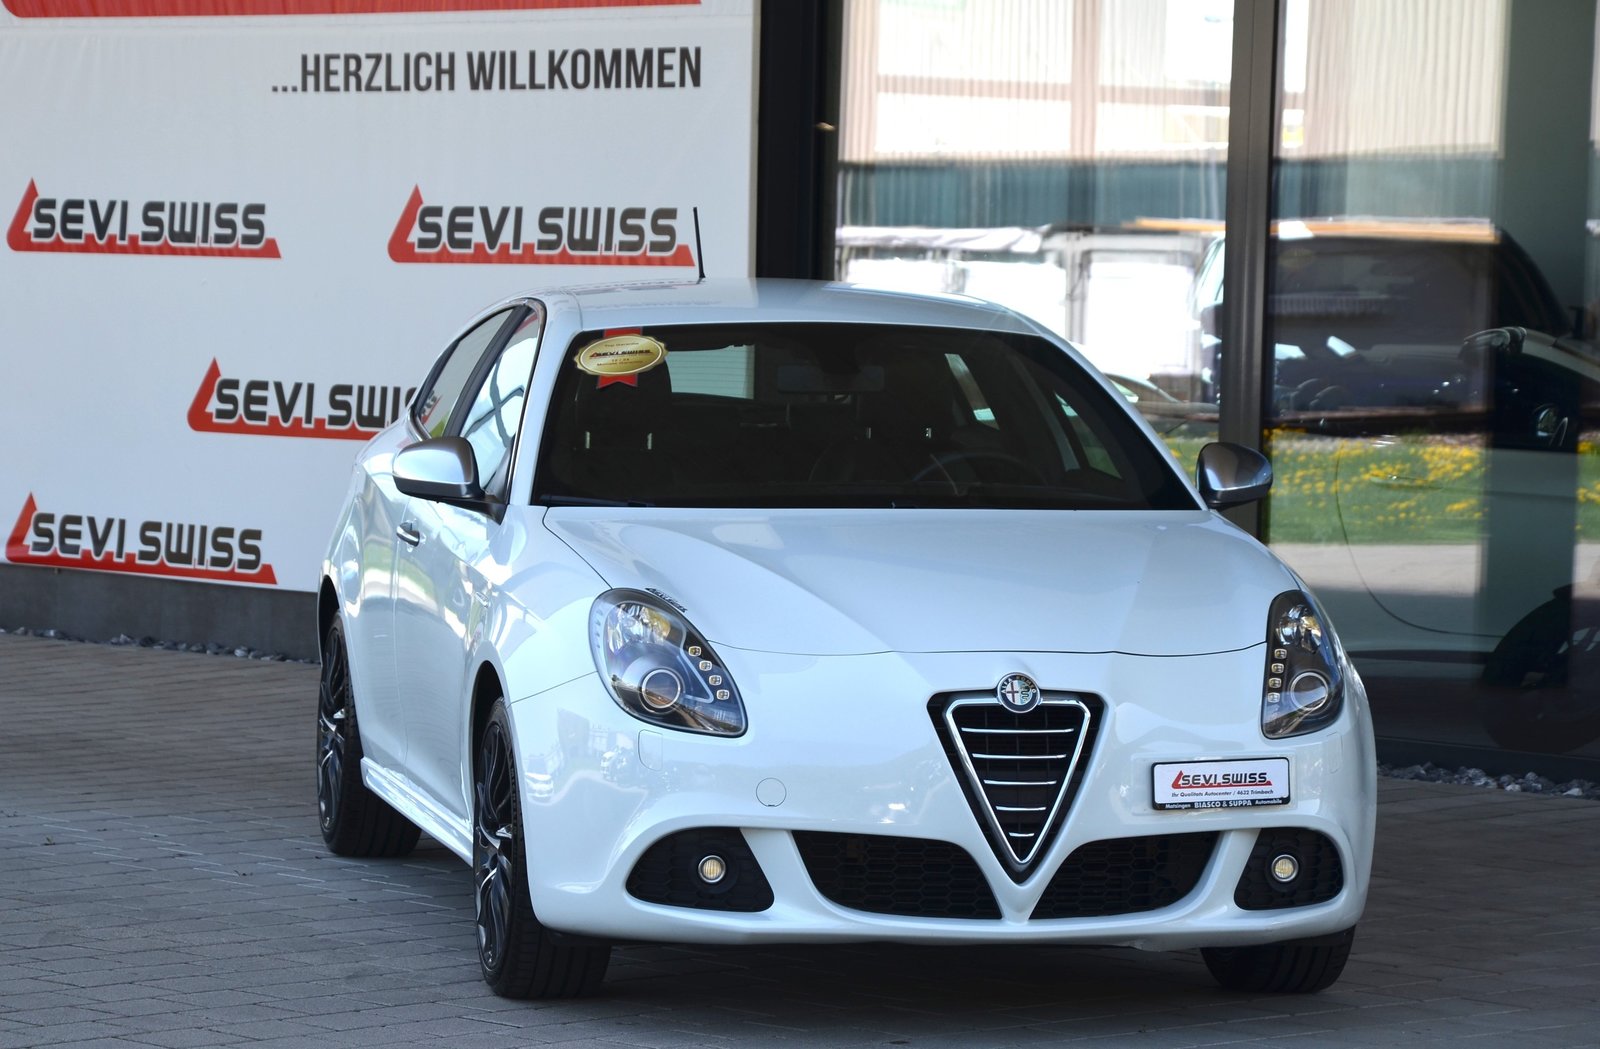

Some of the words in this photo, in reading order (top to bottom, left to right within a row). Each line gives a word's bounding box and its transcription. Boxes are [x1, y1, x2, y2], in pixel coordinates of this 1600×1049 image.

[272, 52, 456, 93] ...HERZLICH
[467, 46, 702, 90] WILLKOMMEN
[32, 198, 128, 242] SEVI
[141, 201, 266, 246] SWISS
[416, 206, 524, 250] SEVI
[536, 207, 678, 254] SWISS
[215, 378, 315, 426] SEVI
[327, 385, 417, 429] SWI
[31, 512, 126, 560] SEVI
[138, 521, 262, 571] SWISS
[1181, 774, 1217, 786] SEVI
[1222, 772, 1267, 784] SWISS
